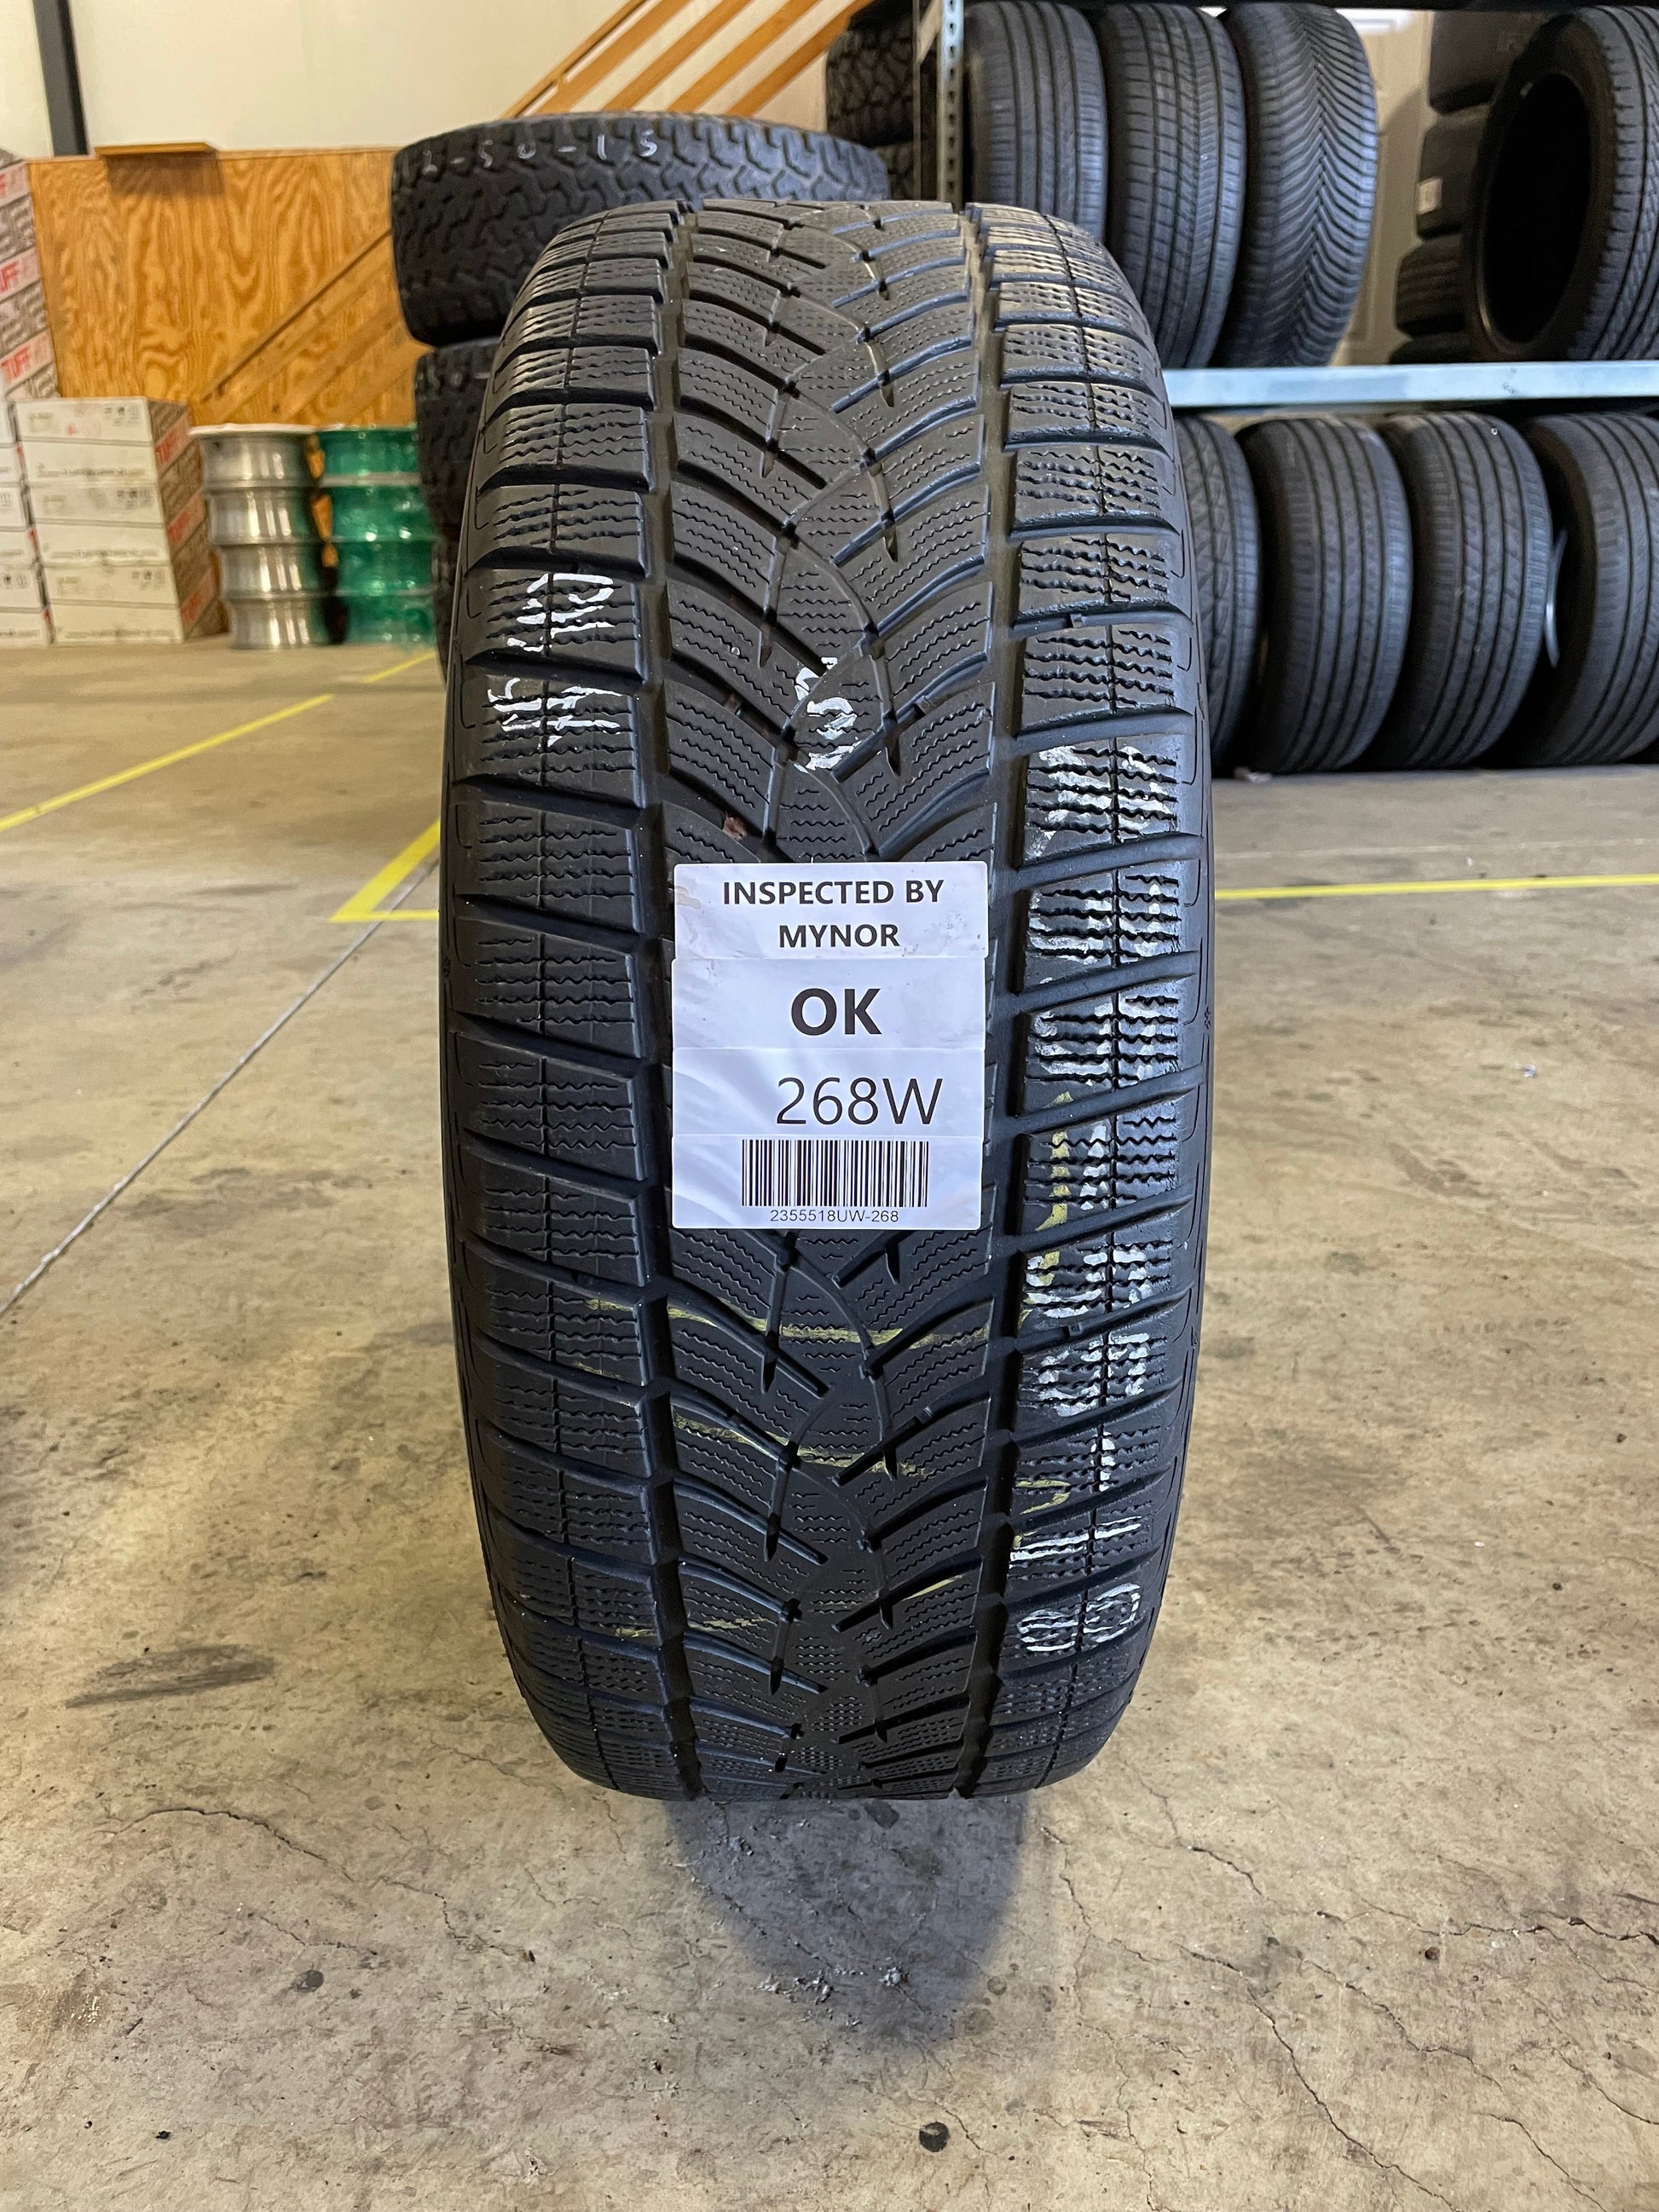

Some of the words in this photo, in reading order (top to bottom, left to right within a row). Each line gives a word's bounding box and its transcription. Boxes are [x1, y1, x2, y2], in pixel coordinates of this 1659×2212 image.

[724, 881, 894, 905] INSPECTED
[905, 880, 944, 904] BY
[779, 924, 900, 948] MYNOR
[791, 988, 882, 1036] OK
[777, 1077, 943, 1125] 268W
[770, 1210, 899, 1222] 2355518UW-268
